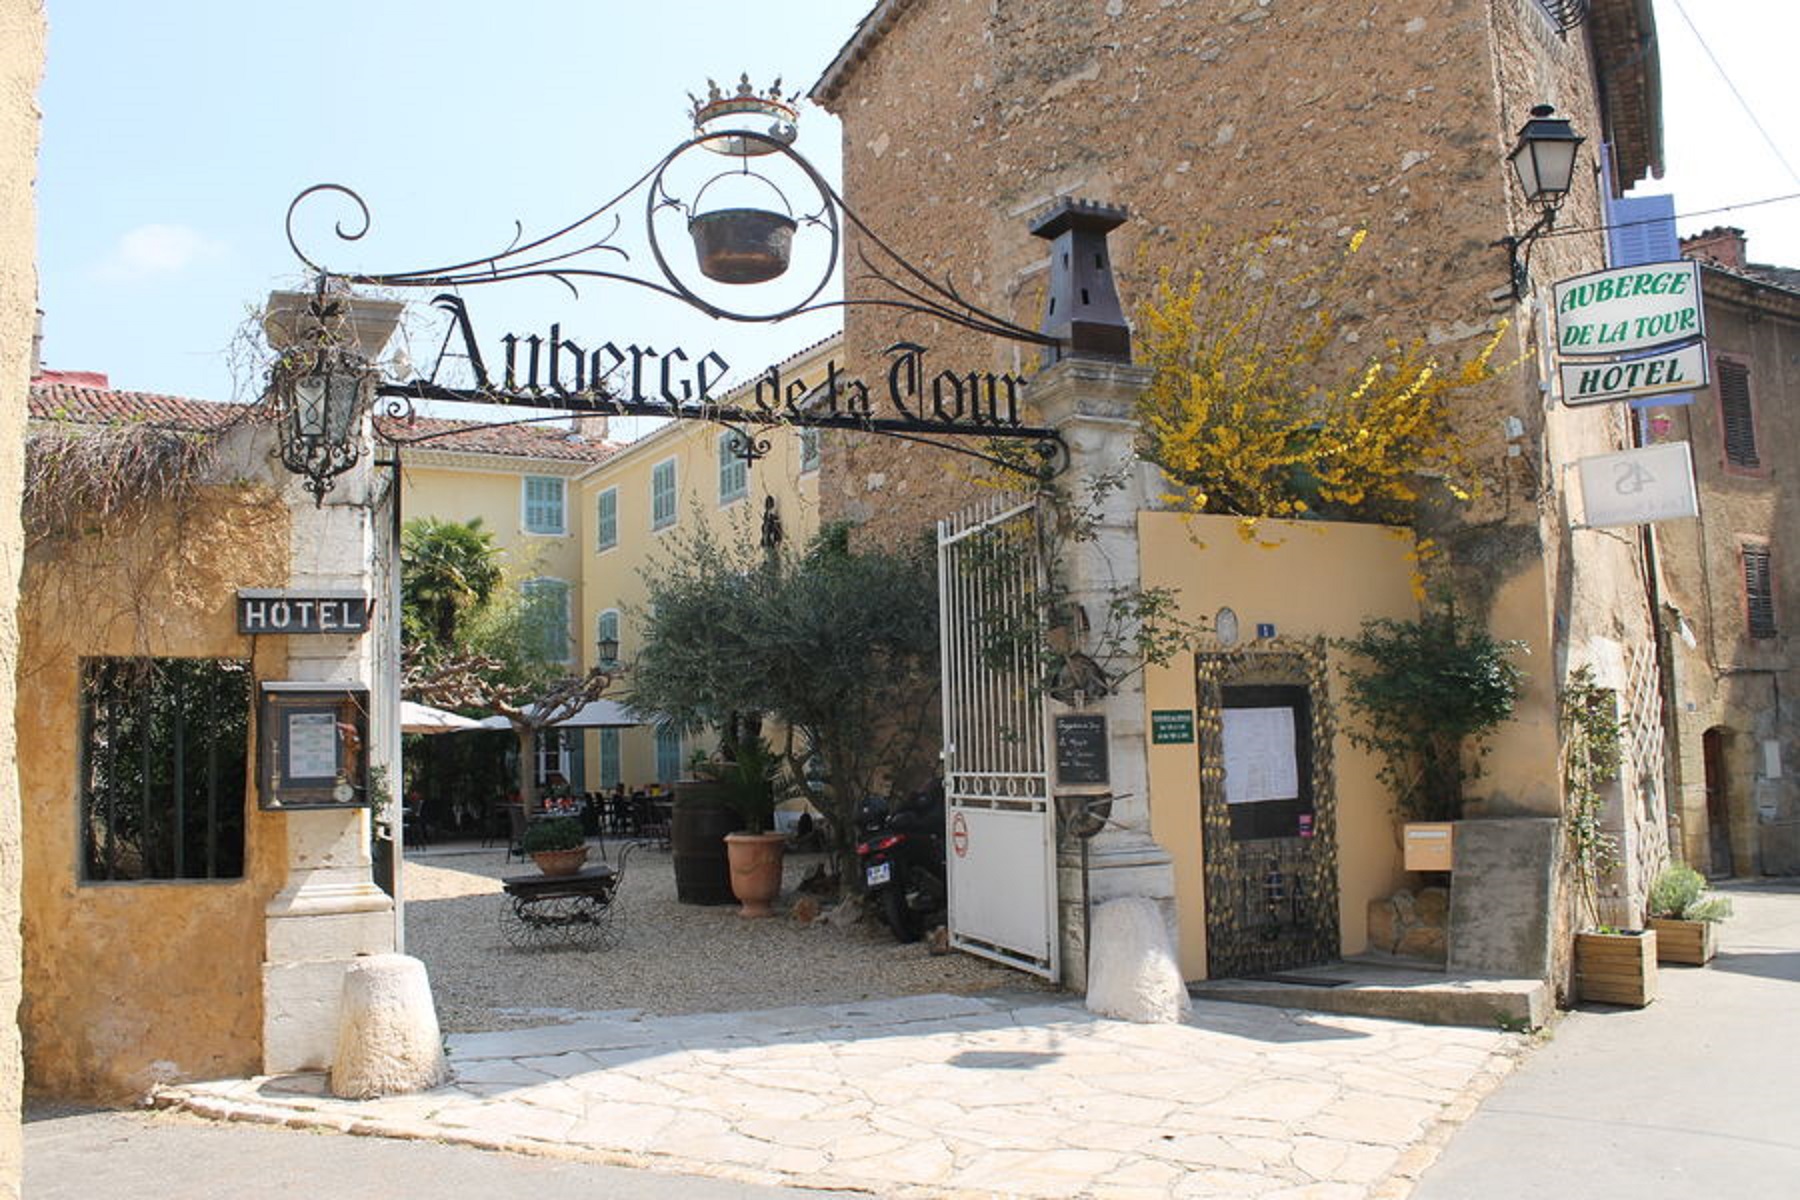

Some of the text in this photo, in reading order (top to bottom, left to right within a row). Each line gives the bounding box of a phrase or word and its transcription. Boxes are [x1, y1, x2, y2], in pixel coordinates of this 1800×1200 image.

[1560, 271, 1692, 315] AUBERGE
[1561, 307, 1697, 348] DE LA TOUR
[410, 293, 731, 410] Auberge
[755, 365, 806, 417] de
[882, 342, 1028, 428] Tour
[1578, 358, 1684, 395] HOTEL
[245, 601, 362, 629] HOTEL
